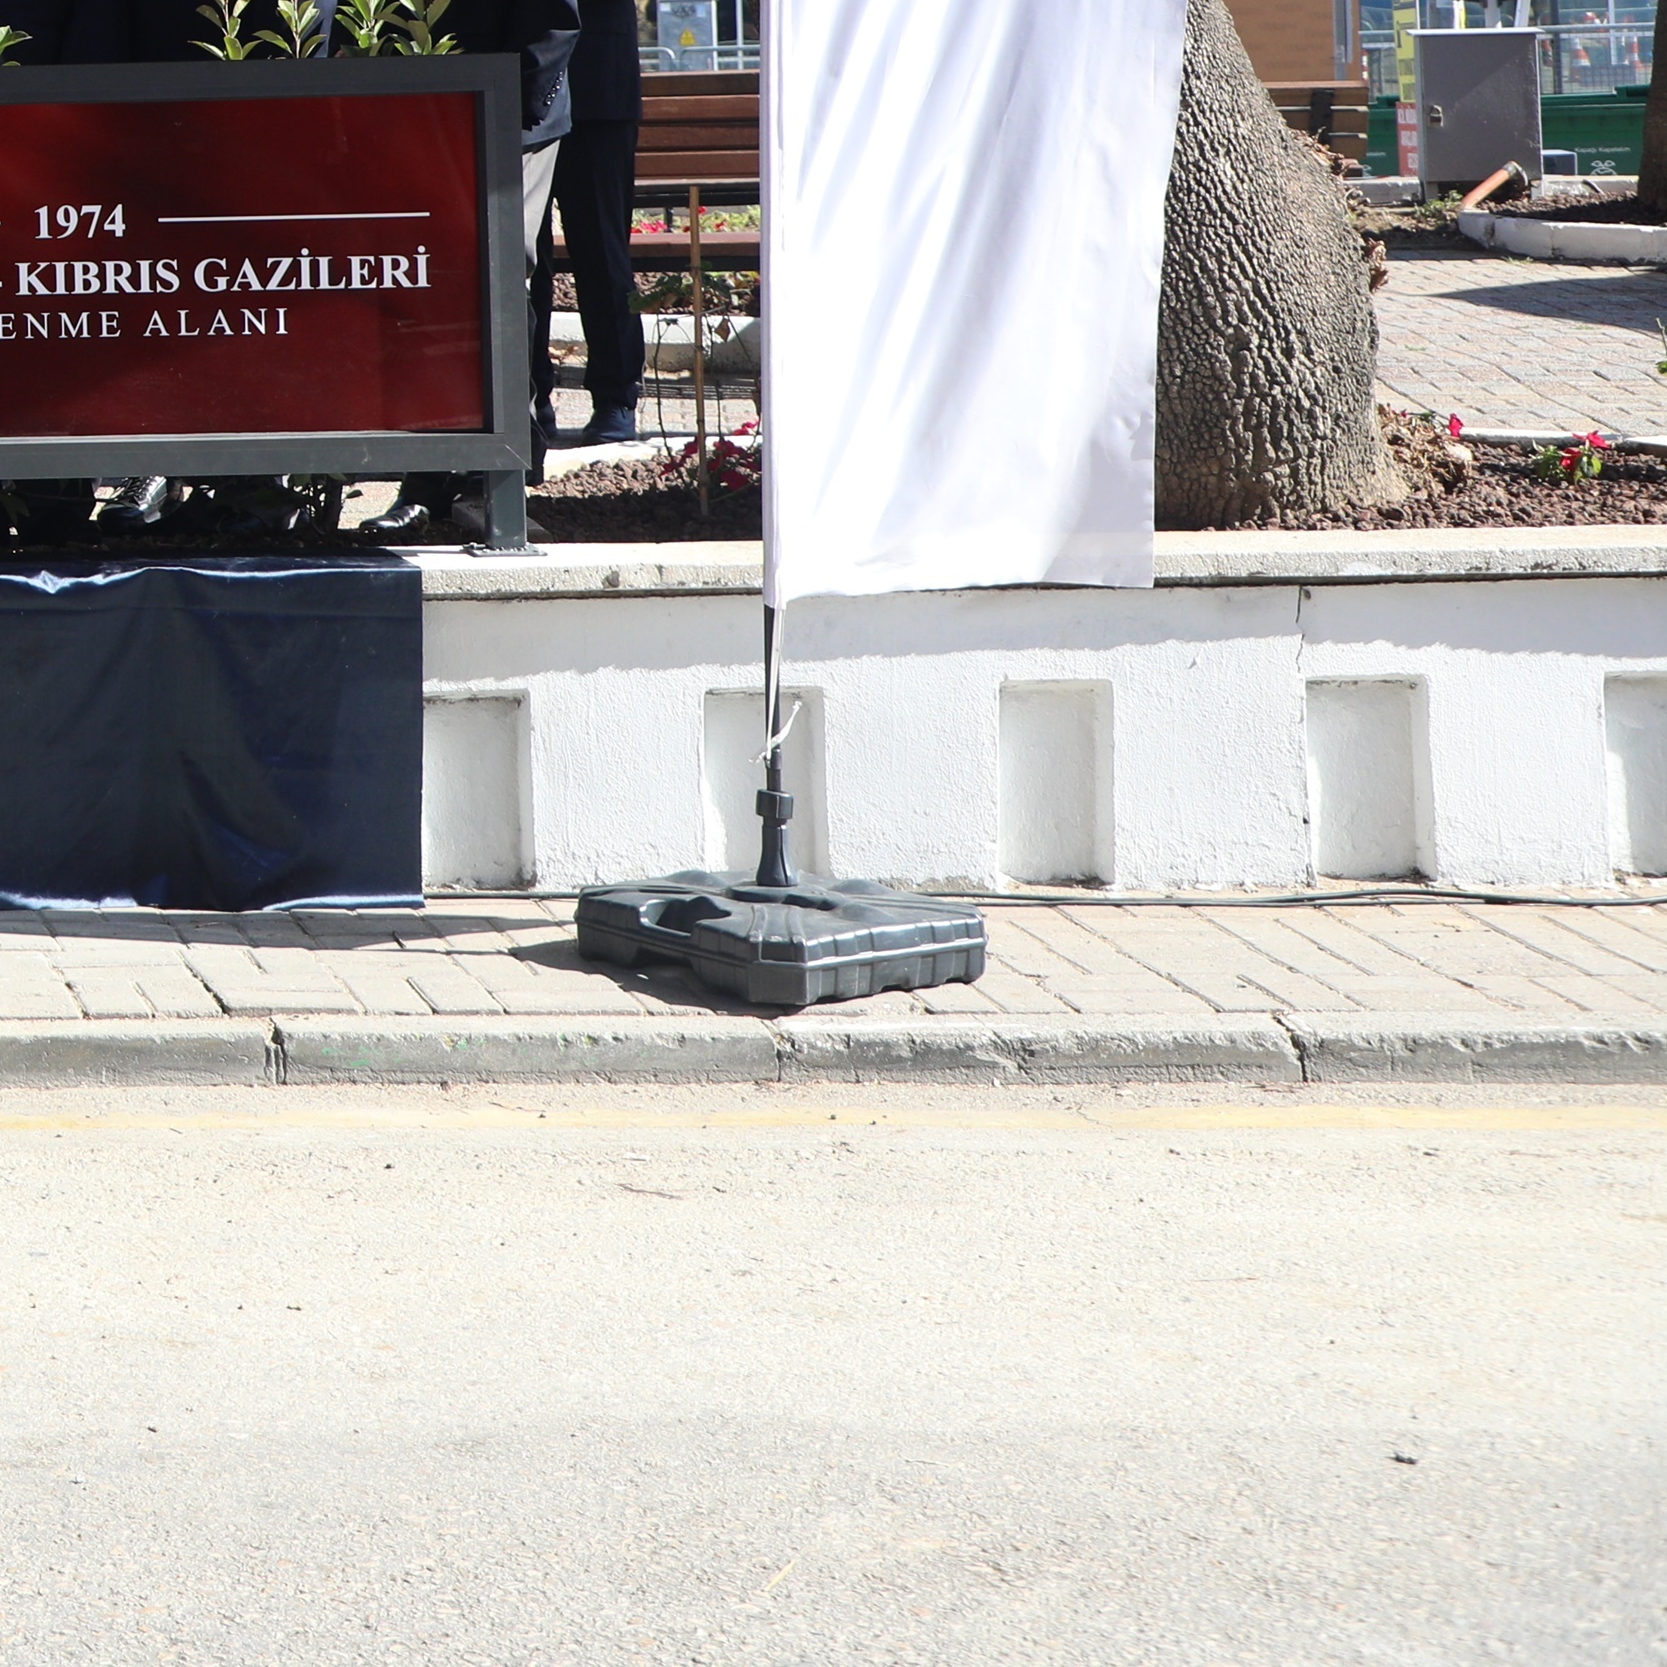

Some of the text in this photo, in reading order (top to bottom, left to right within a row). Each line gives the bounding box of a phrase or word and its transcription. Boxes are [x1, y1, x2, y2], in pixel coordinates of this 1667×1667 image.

[34, 203, 126, 239] 1974
[15, 258, 180, 296] KIBRIS
[194, 245, 432, 293] GAZİLERİ
[143, 307, 289, 337] ALANI
